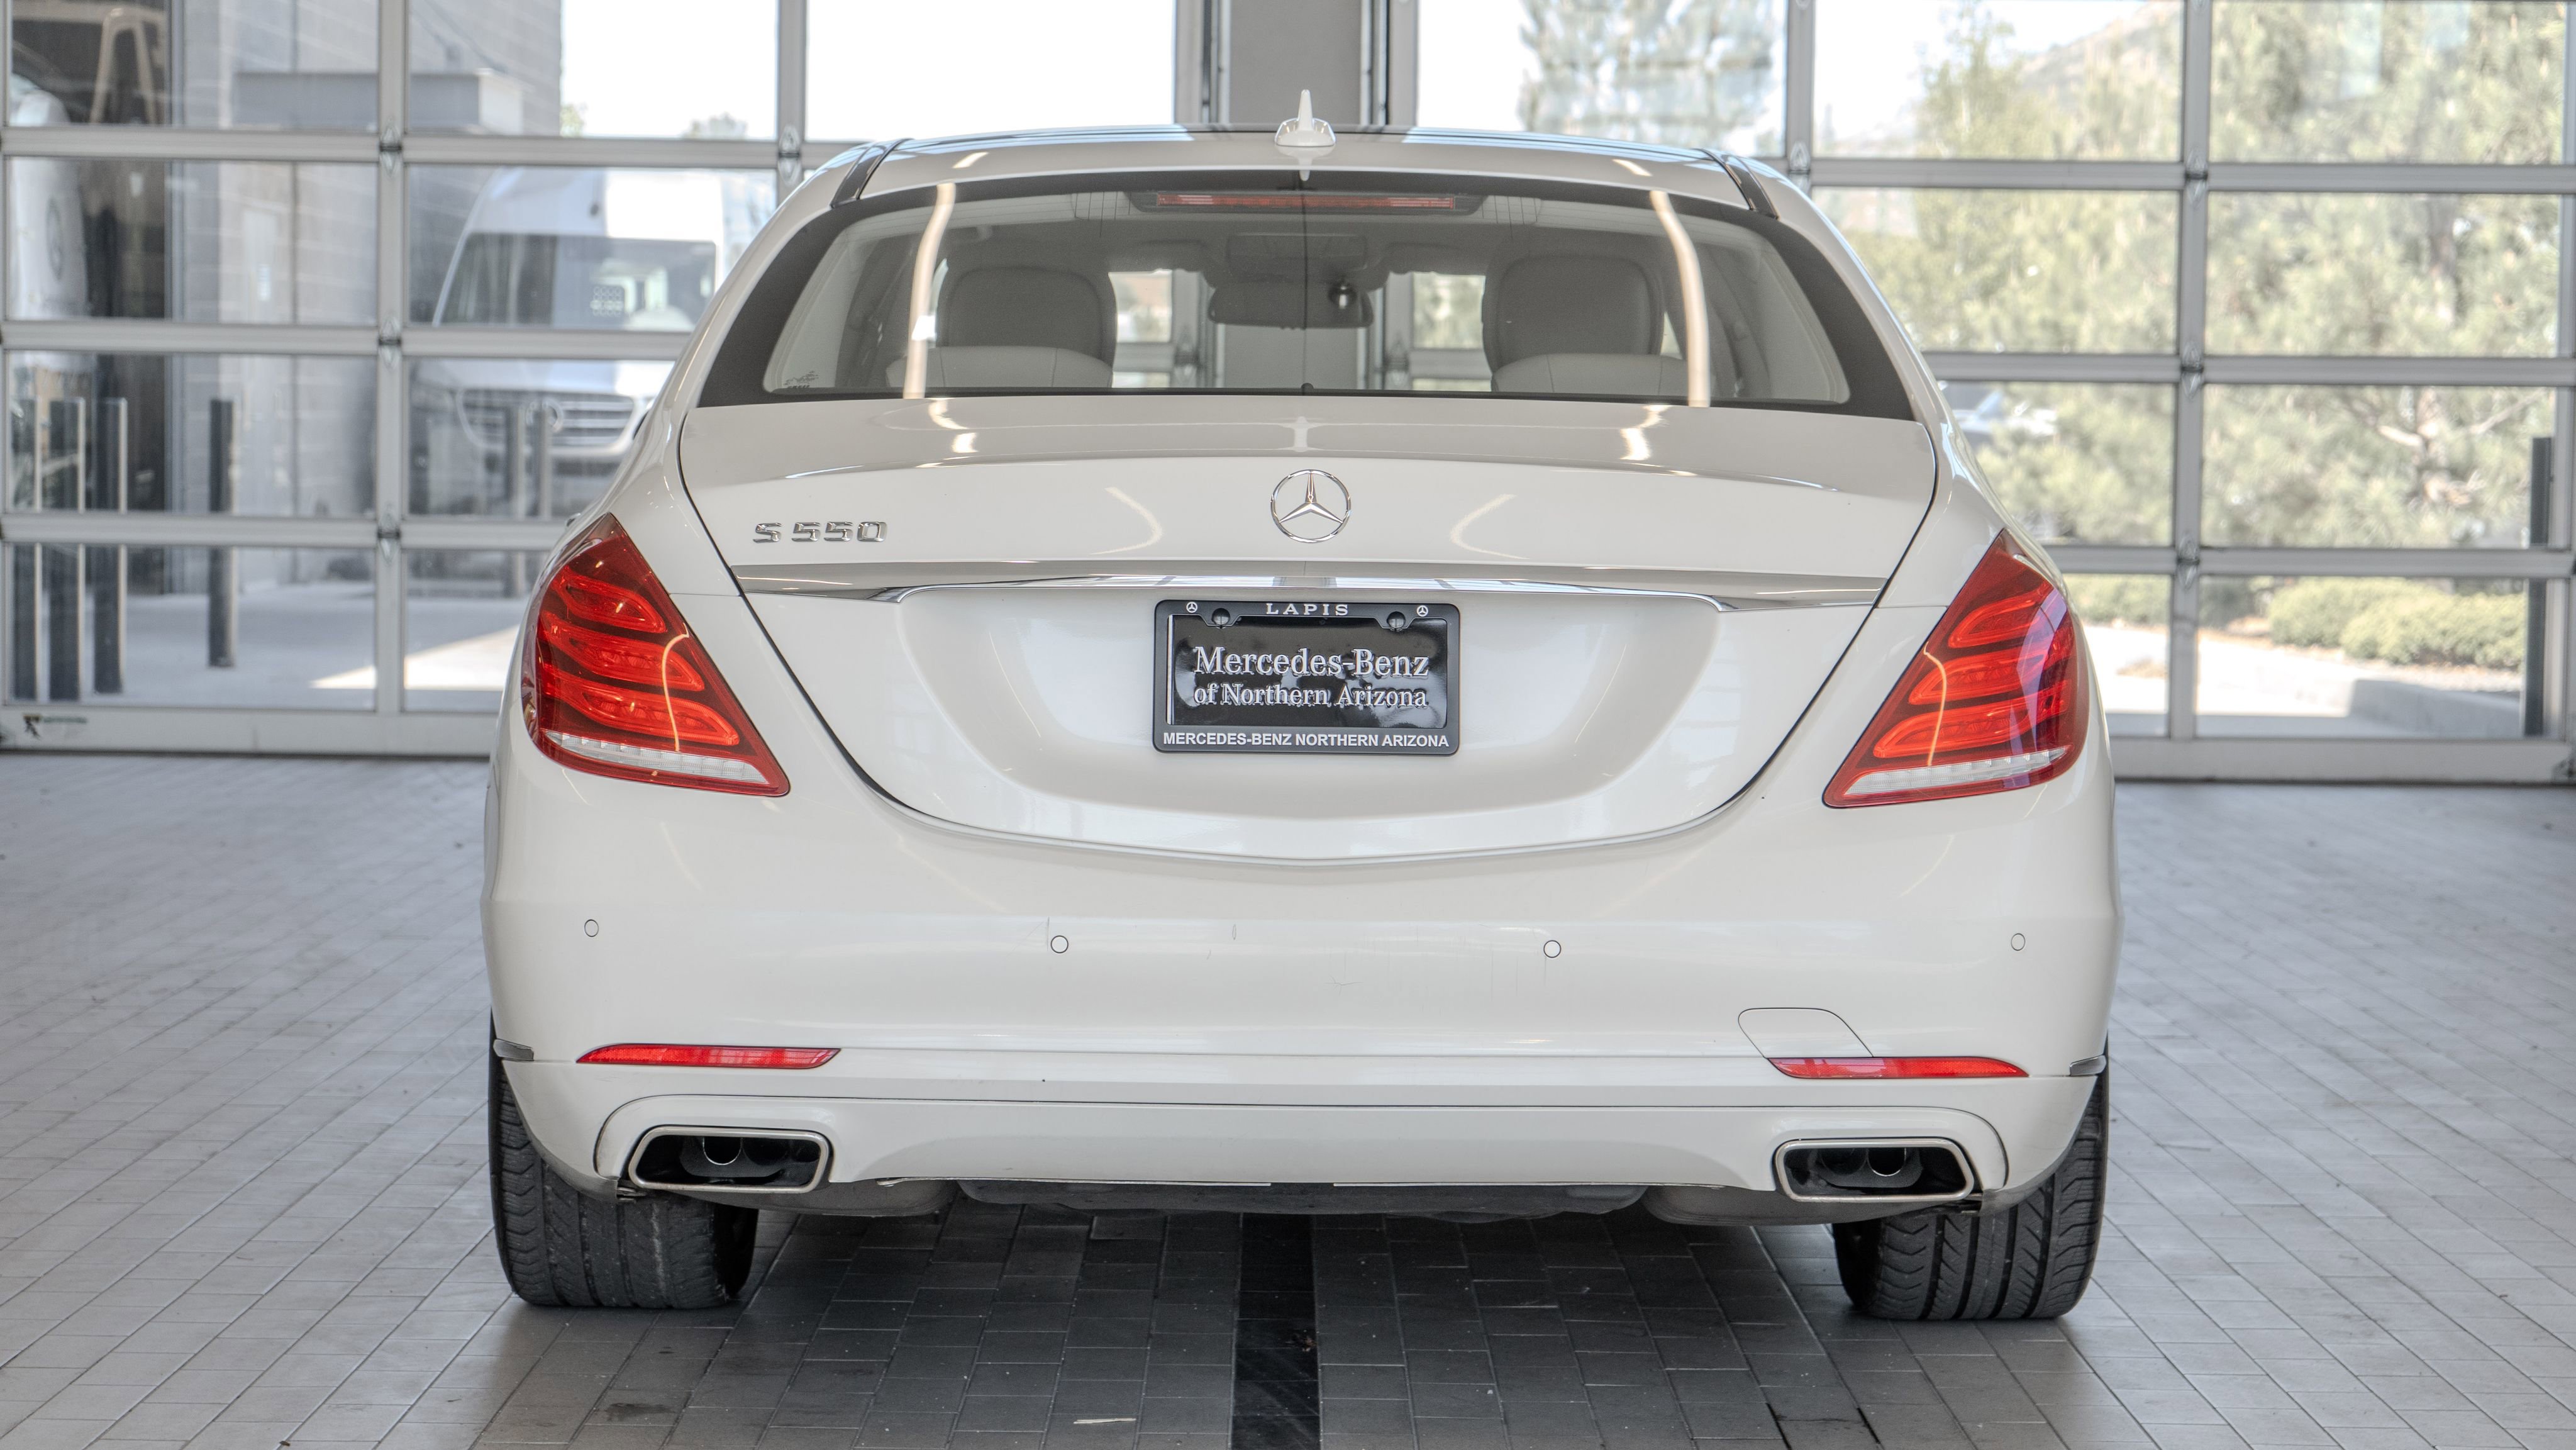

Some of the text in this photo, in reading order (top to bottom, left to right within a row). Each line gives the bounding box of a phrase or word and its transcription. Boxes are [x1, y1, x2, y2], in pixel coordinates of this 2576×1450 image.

[753, 521, 888, 543] S 550
[1266, 603, 1349, 616] LAPIS
[1194, 647, 1430, 676] Mercedes-Benz
[1194, 683, 1428, 707] of Northern Arizona
[1163, 733, 1449, 747] MERCEDES-BENZ NORTHERN ARIZONA
